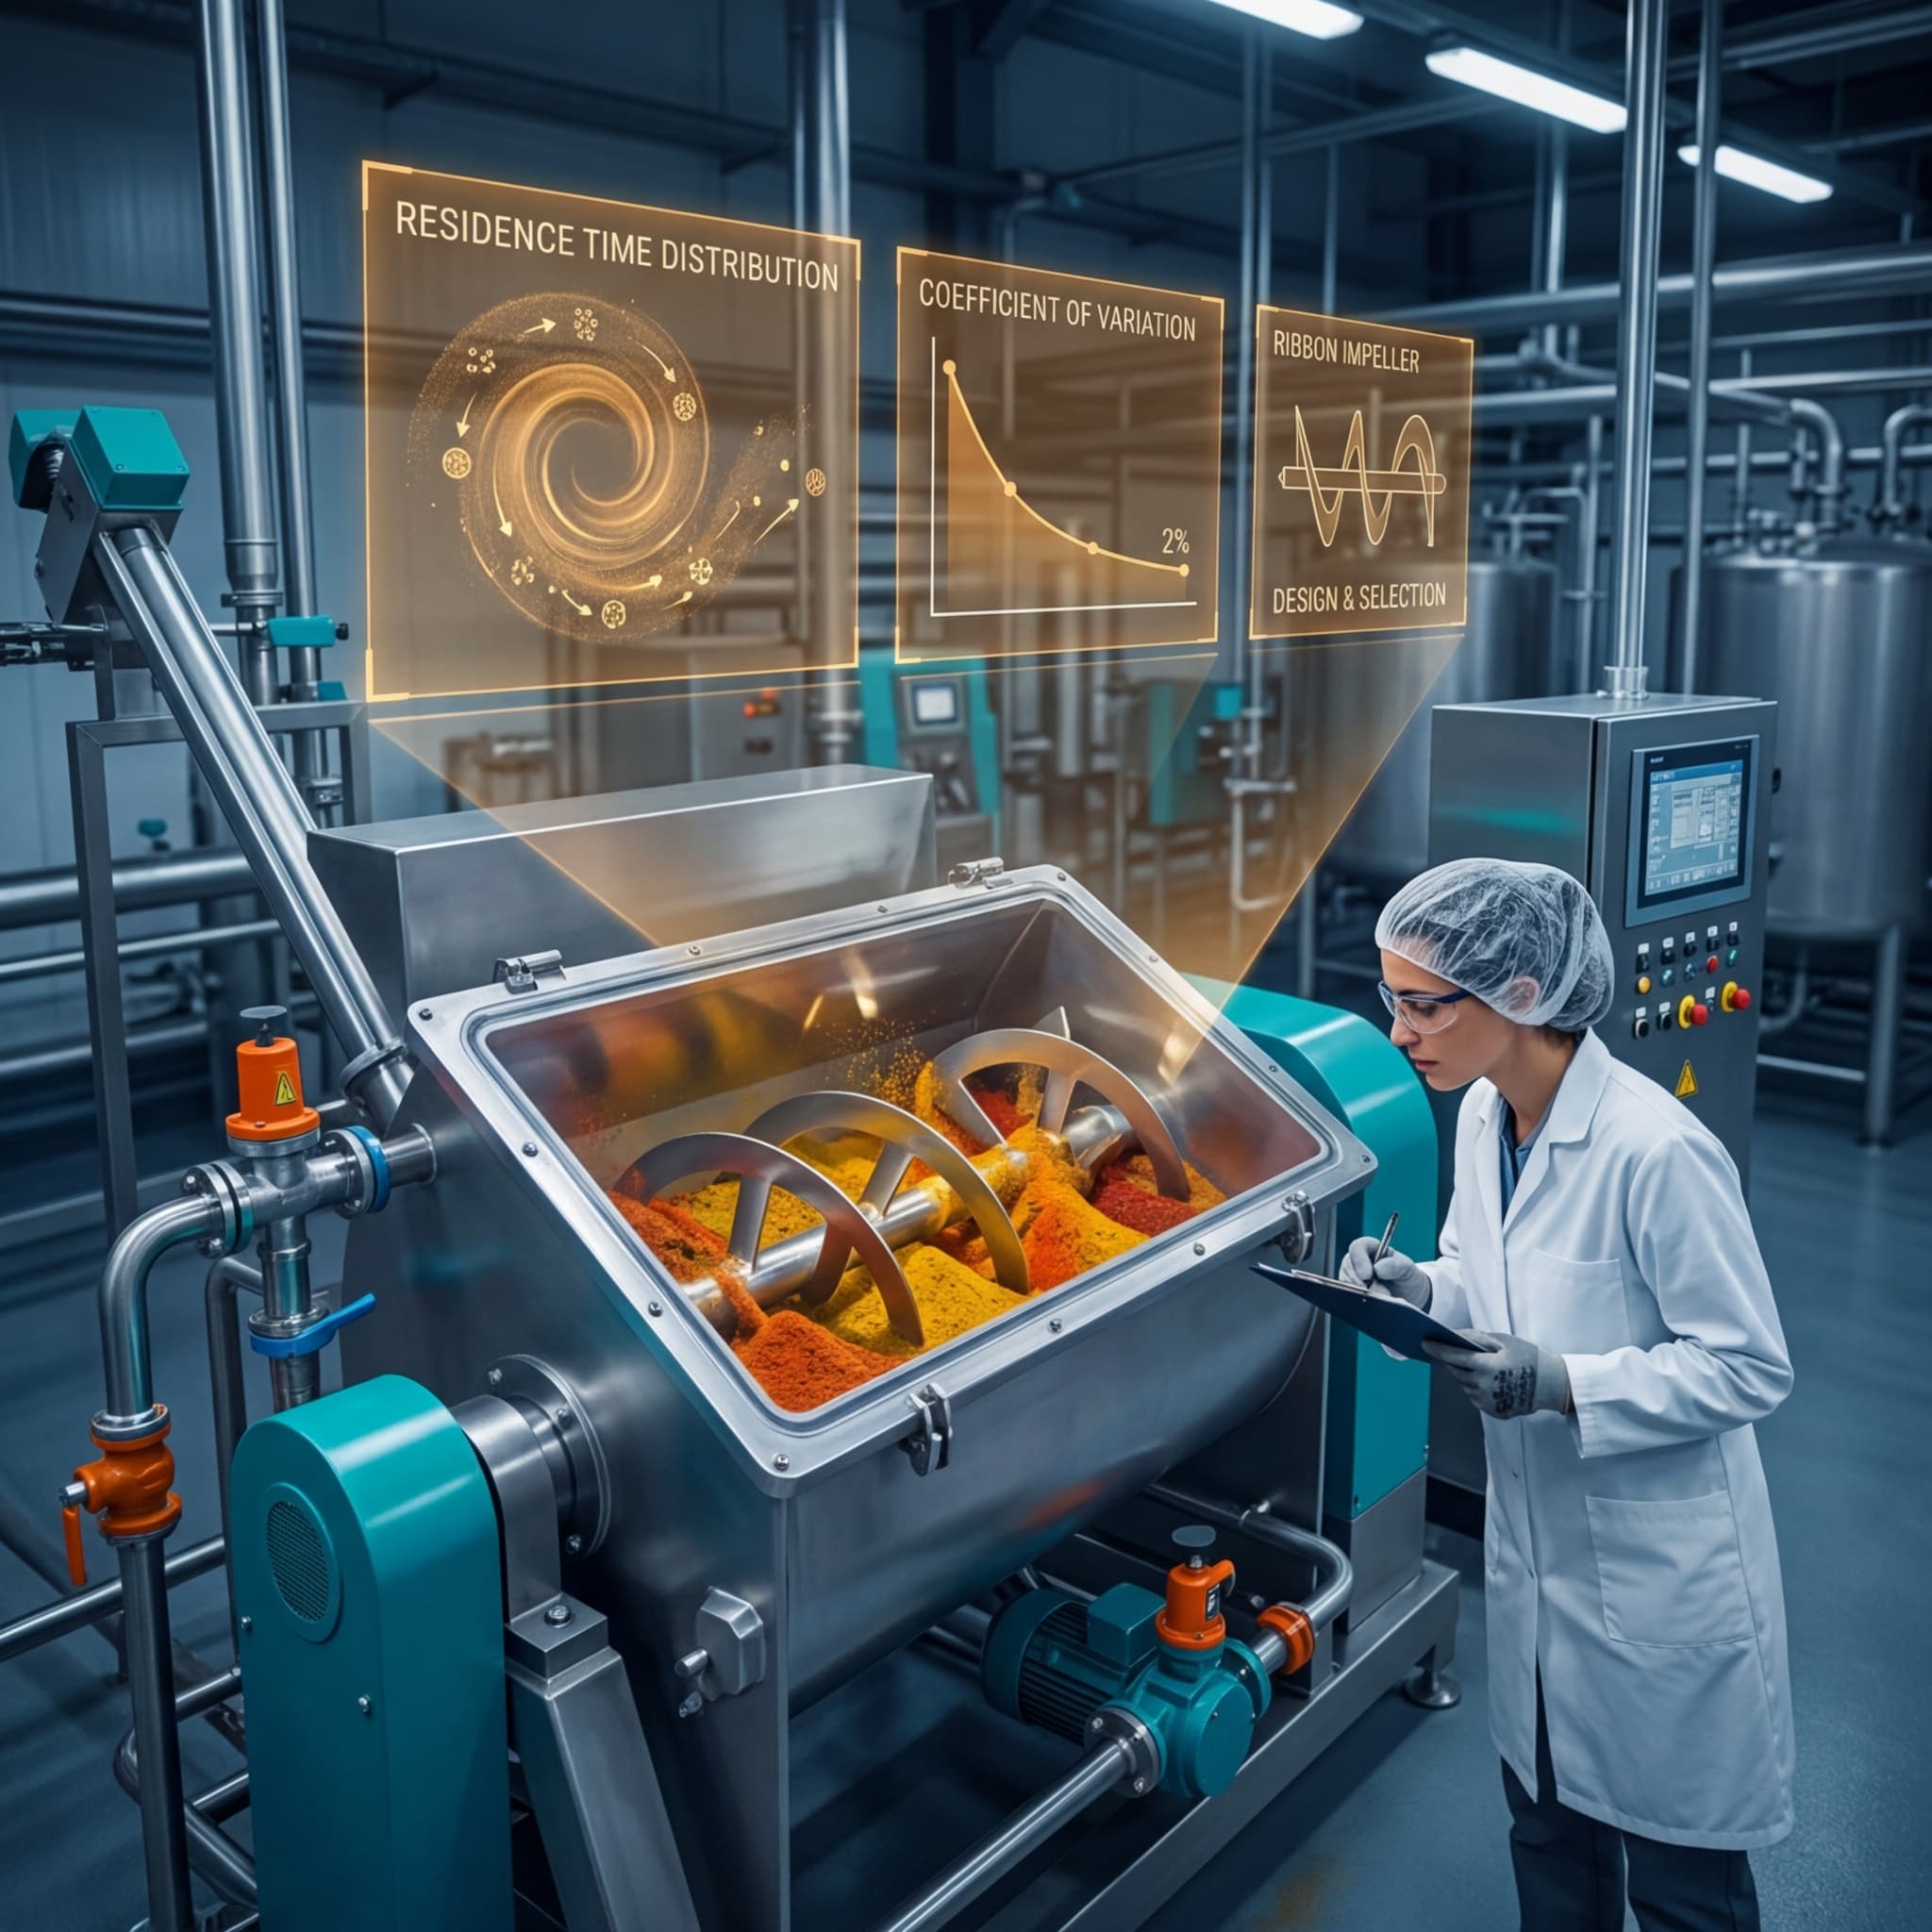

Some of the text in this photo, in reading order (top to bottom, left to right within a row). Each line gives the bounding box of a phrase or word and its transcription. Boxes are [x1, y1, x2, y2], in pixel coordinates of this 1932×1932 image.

[396, 200, 838, 292] RESIDENCE TIME DISTRIBUTION
[919, 277, 1196, 342] COEFFICIENT OF VARIATION
[1274, 329, 1420, 375] RIBBON IMPELLER
[1161, 527, 1190, 555] 2%
[1273, 581, 1446, 614] DESIGN & SELECTION
